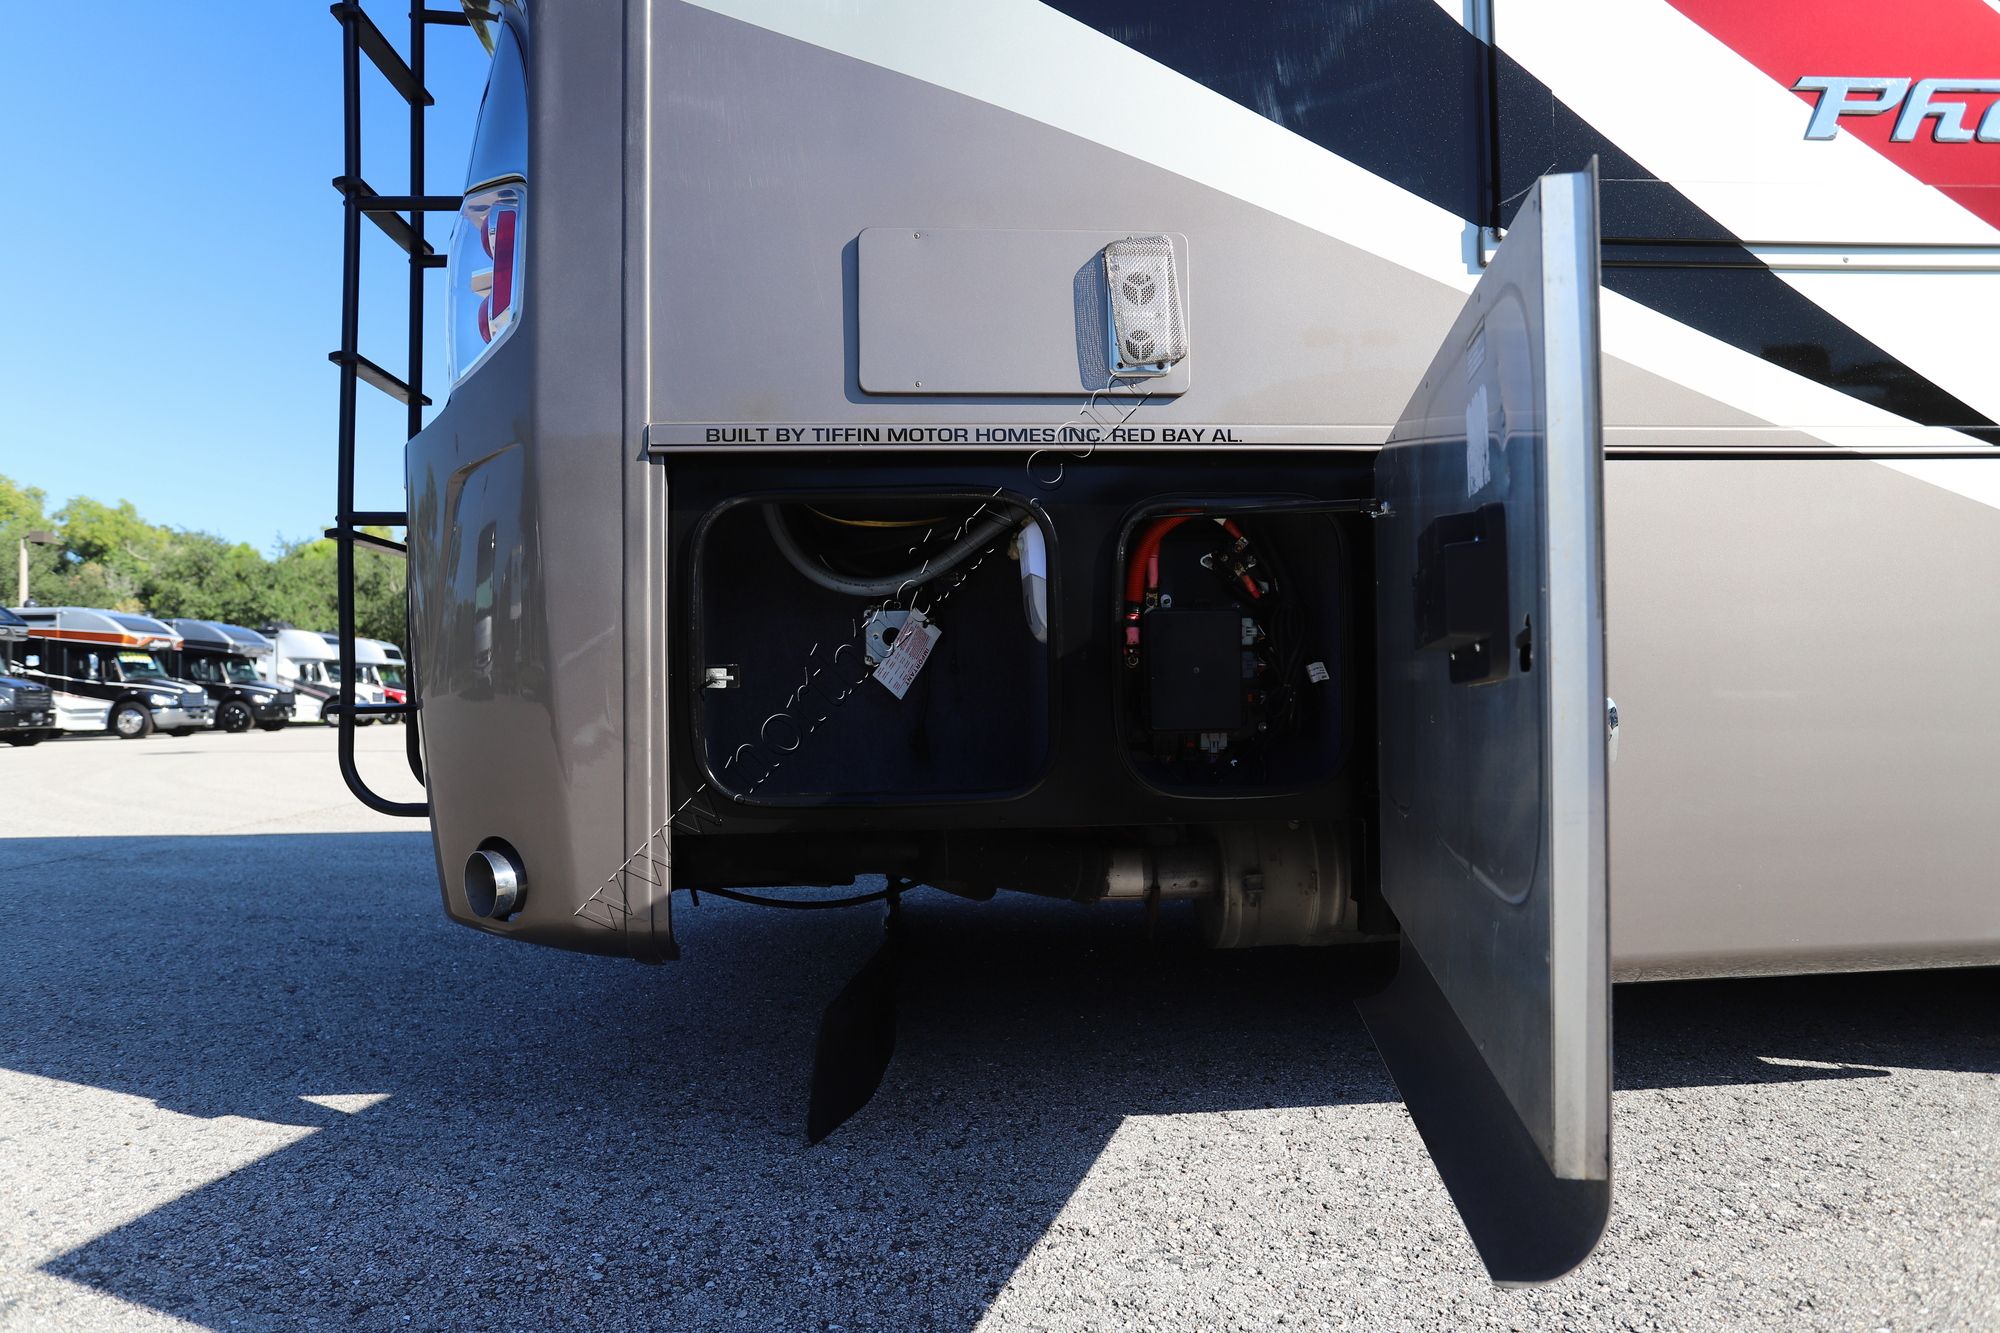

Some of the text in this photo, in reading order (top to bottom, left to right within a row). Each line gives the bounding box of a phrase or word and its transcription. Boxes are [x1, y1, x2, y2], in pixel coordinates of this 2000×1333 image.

[706, 428, 1243, 443] BUILT BY TIFFIN MOTOR HOMES INC. RED BAY AL.
[906, 648, 930, 687] IMPORTANT
